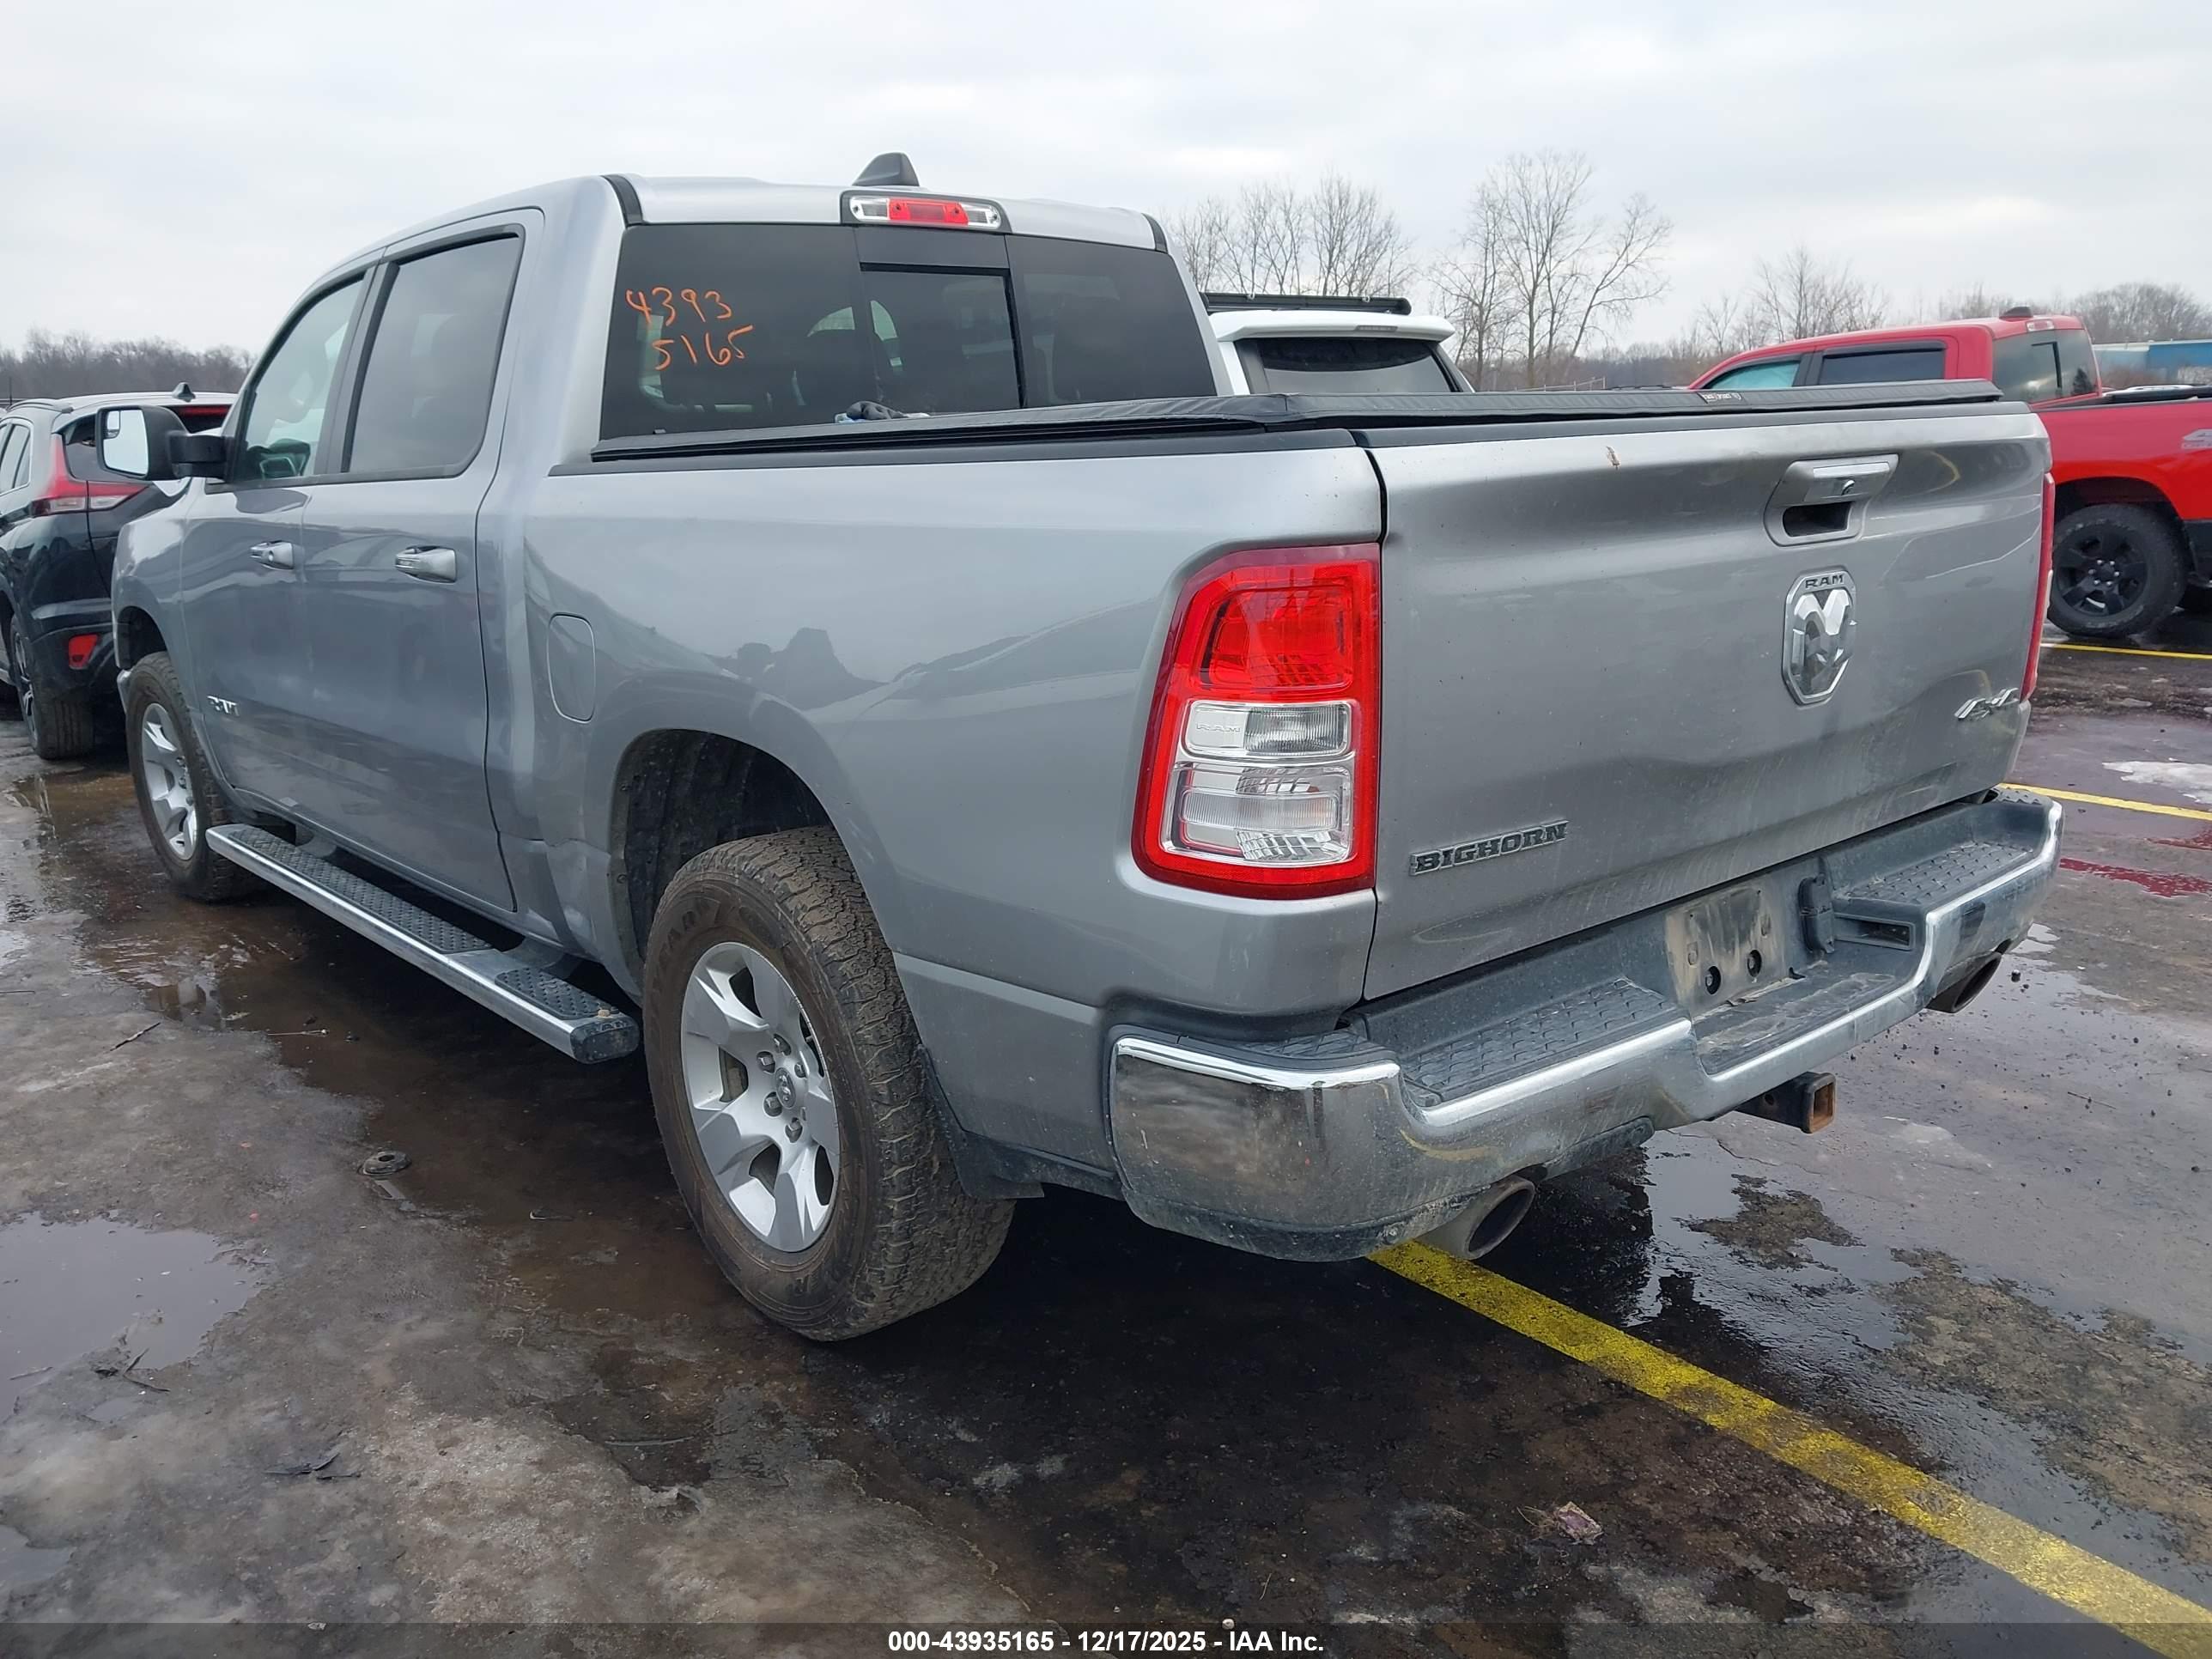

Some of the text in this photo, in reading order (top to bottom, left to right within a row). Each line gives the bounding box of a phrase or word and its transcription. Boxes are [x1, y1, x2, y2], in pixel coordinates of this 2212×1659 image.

[626, 286, 732, 328] 4393
[652, 325, 754, 371] 5165
[1805, 574, 1844, 589] RAM
[1196, 723, 1242, 732] RAM
[1409, 818, 1569, 876] BIGHORN
